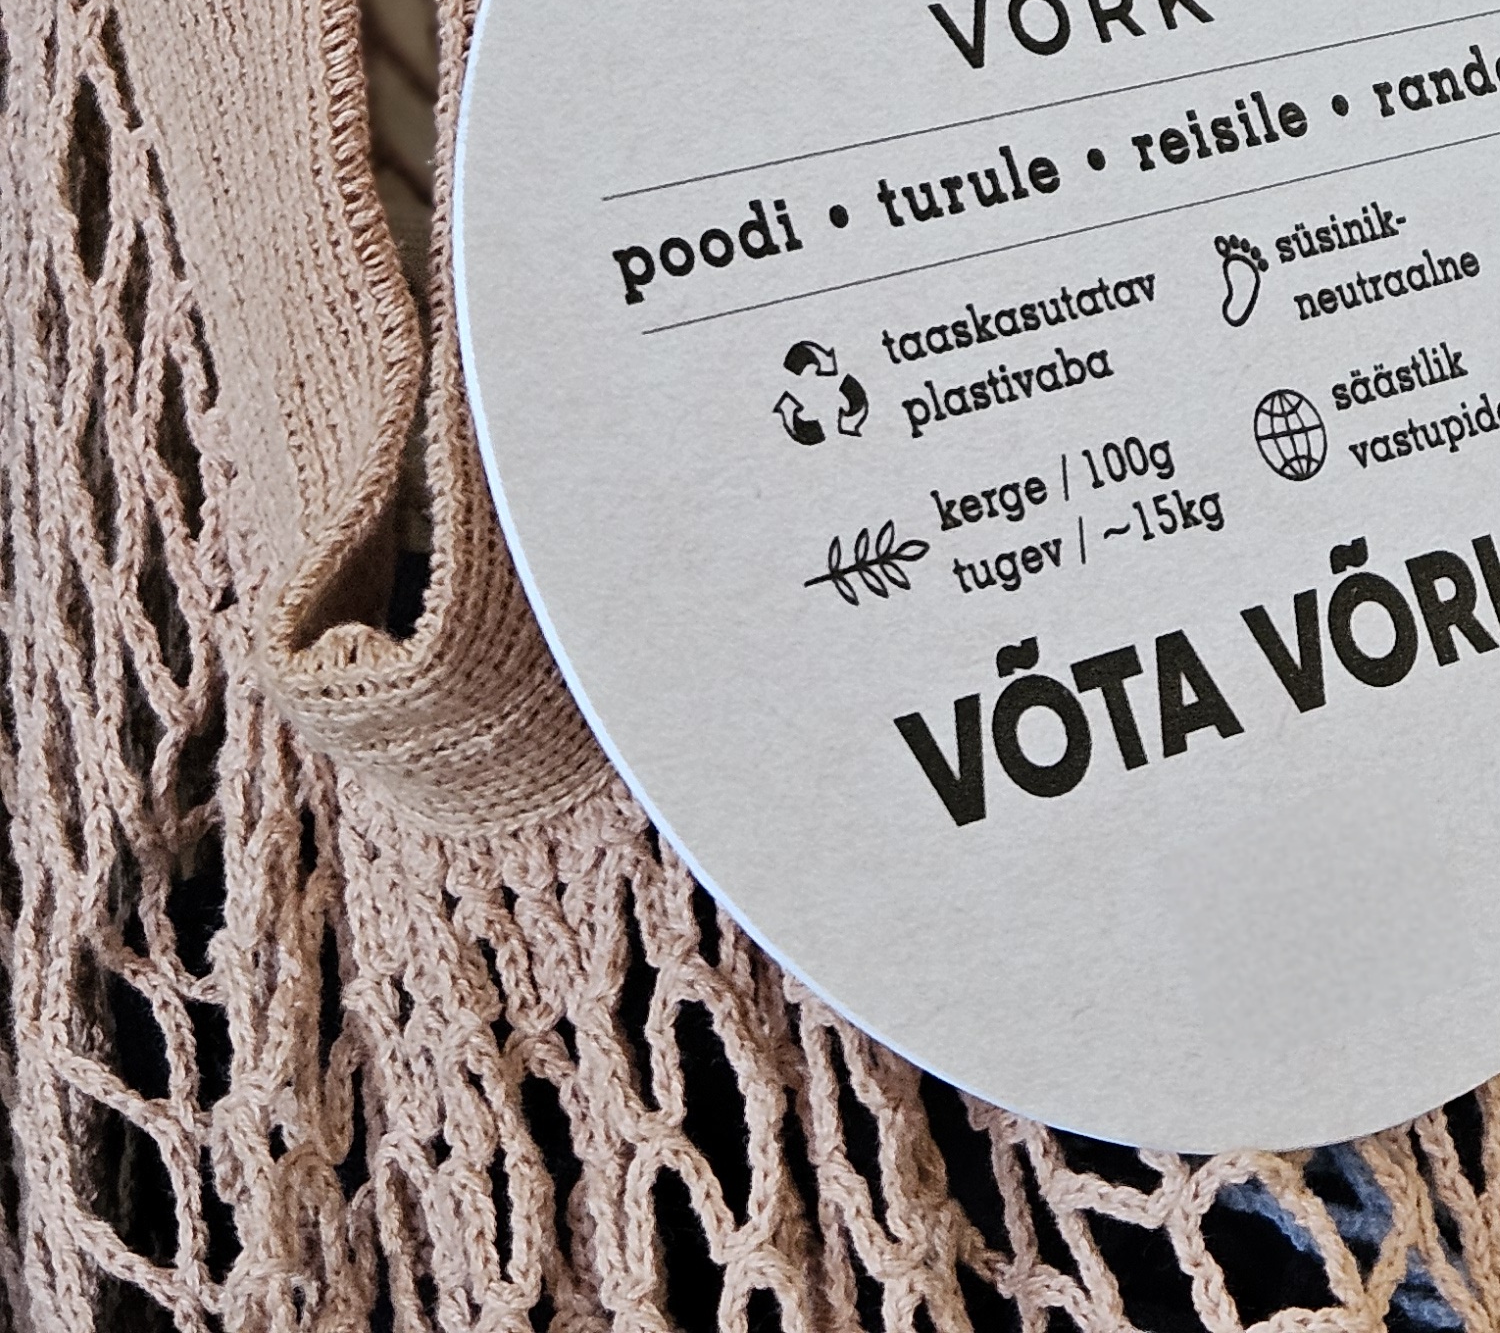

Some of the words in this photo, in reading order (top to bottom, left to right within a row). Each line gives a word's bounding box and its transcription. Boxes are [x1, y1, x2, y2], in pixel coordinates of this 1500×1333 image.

[612, 198, 804, 306] poodi
[876, 145, 1061, 228] turule
[1131, 91, 1308, 172] reisile
[1275, 201, 1407, 264] süsinik-
[881, 273, 1156, 365] taaskasutatav
[1293, 250, 1480, 321] neutraalne
[901, 347, 1115, 439] plastivaba
[1332, 341, 1469, 411] säästlik
[929, 476, 1048, 532] kerge
[1081, 436, 1175, 490] 100g
[952, 537, 1063, 594] tugev
[1103, 489, 1225, 542] ~15kg
[892, 629, 1245, 827] VÕTA
